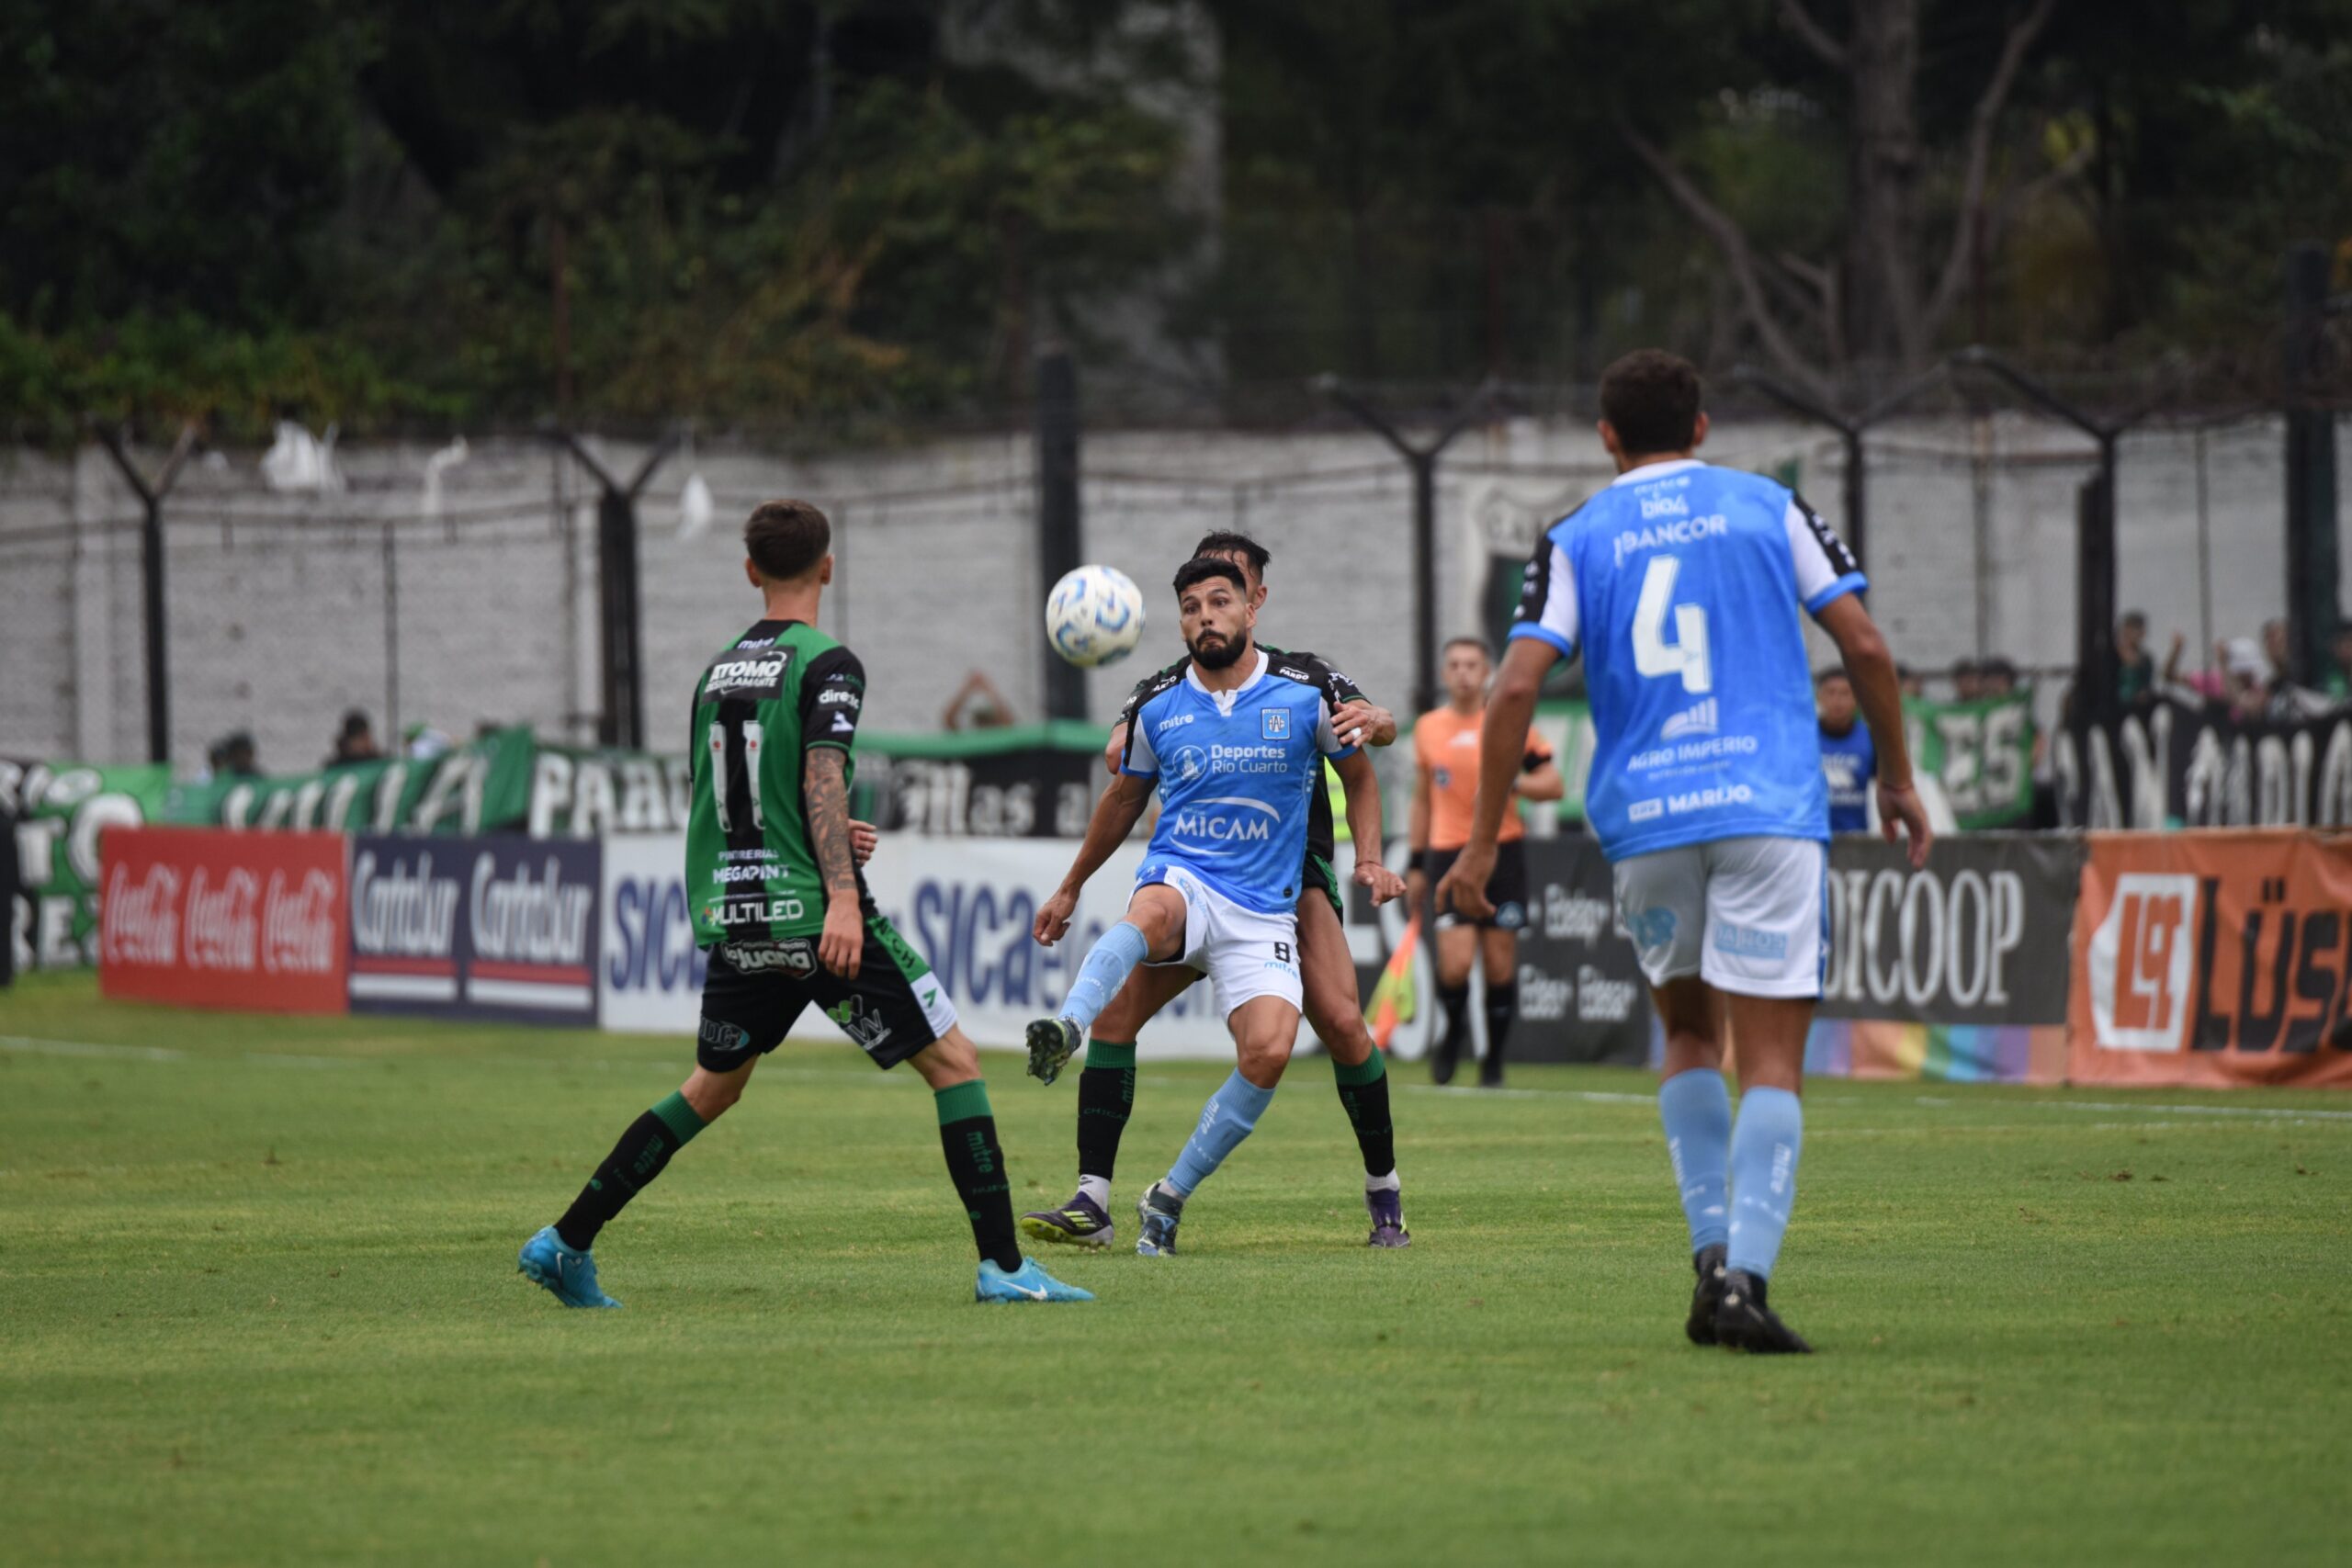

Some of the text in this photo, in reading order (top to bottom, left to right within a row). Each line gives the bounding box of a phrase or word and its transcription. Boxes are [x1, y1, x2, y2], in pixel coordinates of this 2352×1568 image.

[1632, 554, 1712, 694] 4
[709, 660, 785, 683] ATOMO
[1279, 668, 1309, 681] PARDO
[1159, 714, 1194, 732] mitre
[1211, 744, 1285, 760] Deportes
[1626, 735, 1759, 773] AGRO IMPERIO
[708, 720, 766, 832] 11
[1212, 759, 1288, 774] Río Cuarto
[1668, 784, 1752, 816] MARIJO
[1172, 813, 1270, 840] MICAM
[710, 898, 804, 927] MULTILED
[1273, 941, 1291, 964] 8
[2192, 876, 2352, 1054] LÜS
[1264, 962, 1298, 979] mitre
[1200, 1097, 1220, 1135] mitre
[966, 1130, 994, 1174] mitre
